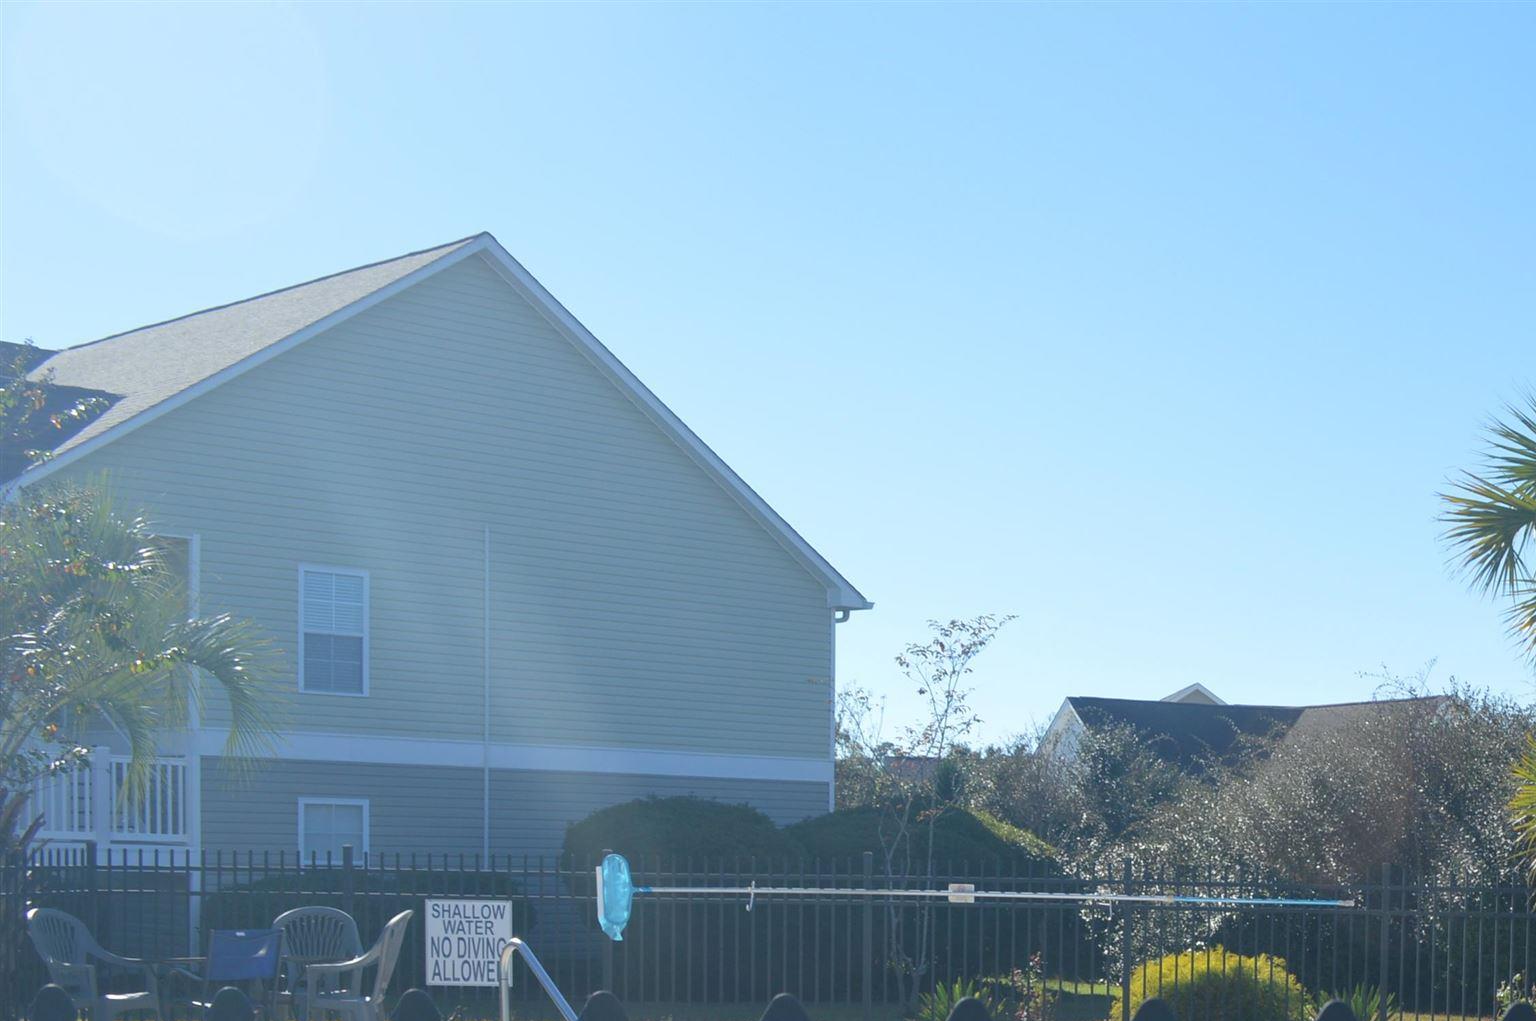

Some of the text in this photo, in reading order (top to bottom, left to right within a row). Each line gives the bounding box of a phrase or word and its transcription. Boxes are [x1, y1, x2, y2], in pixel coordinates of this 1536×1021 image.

[431, 903, 506, 919] SHALLOW
[443, 920, 494, 935] WATER
[430, 936, 452, 958] NO
